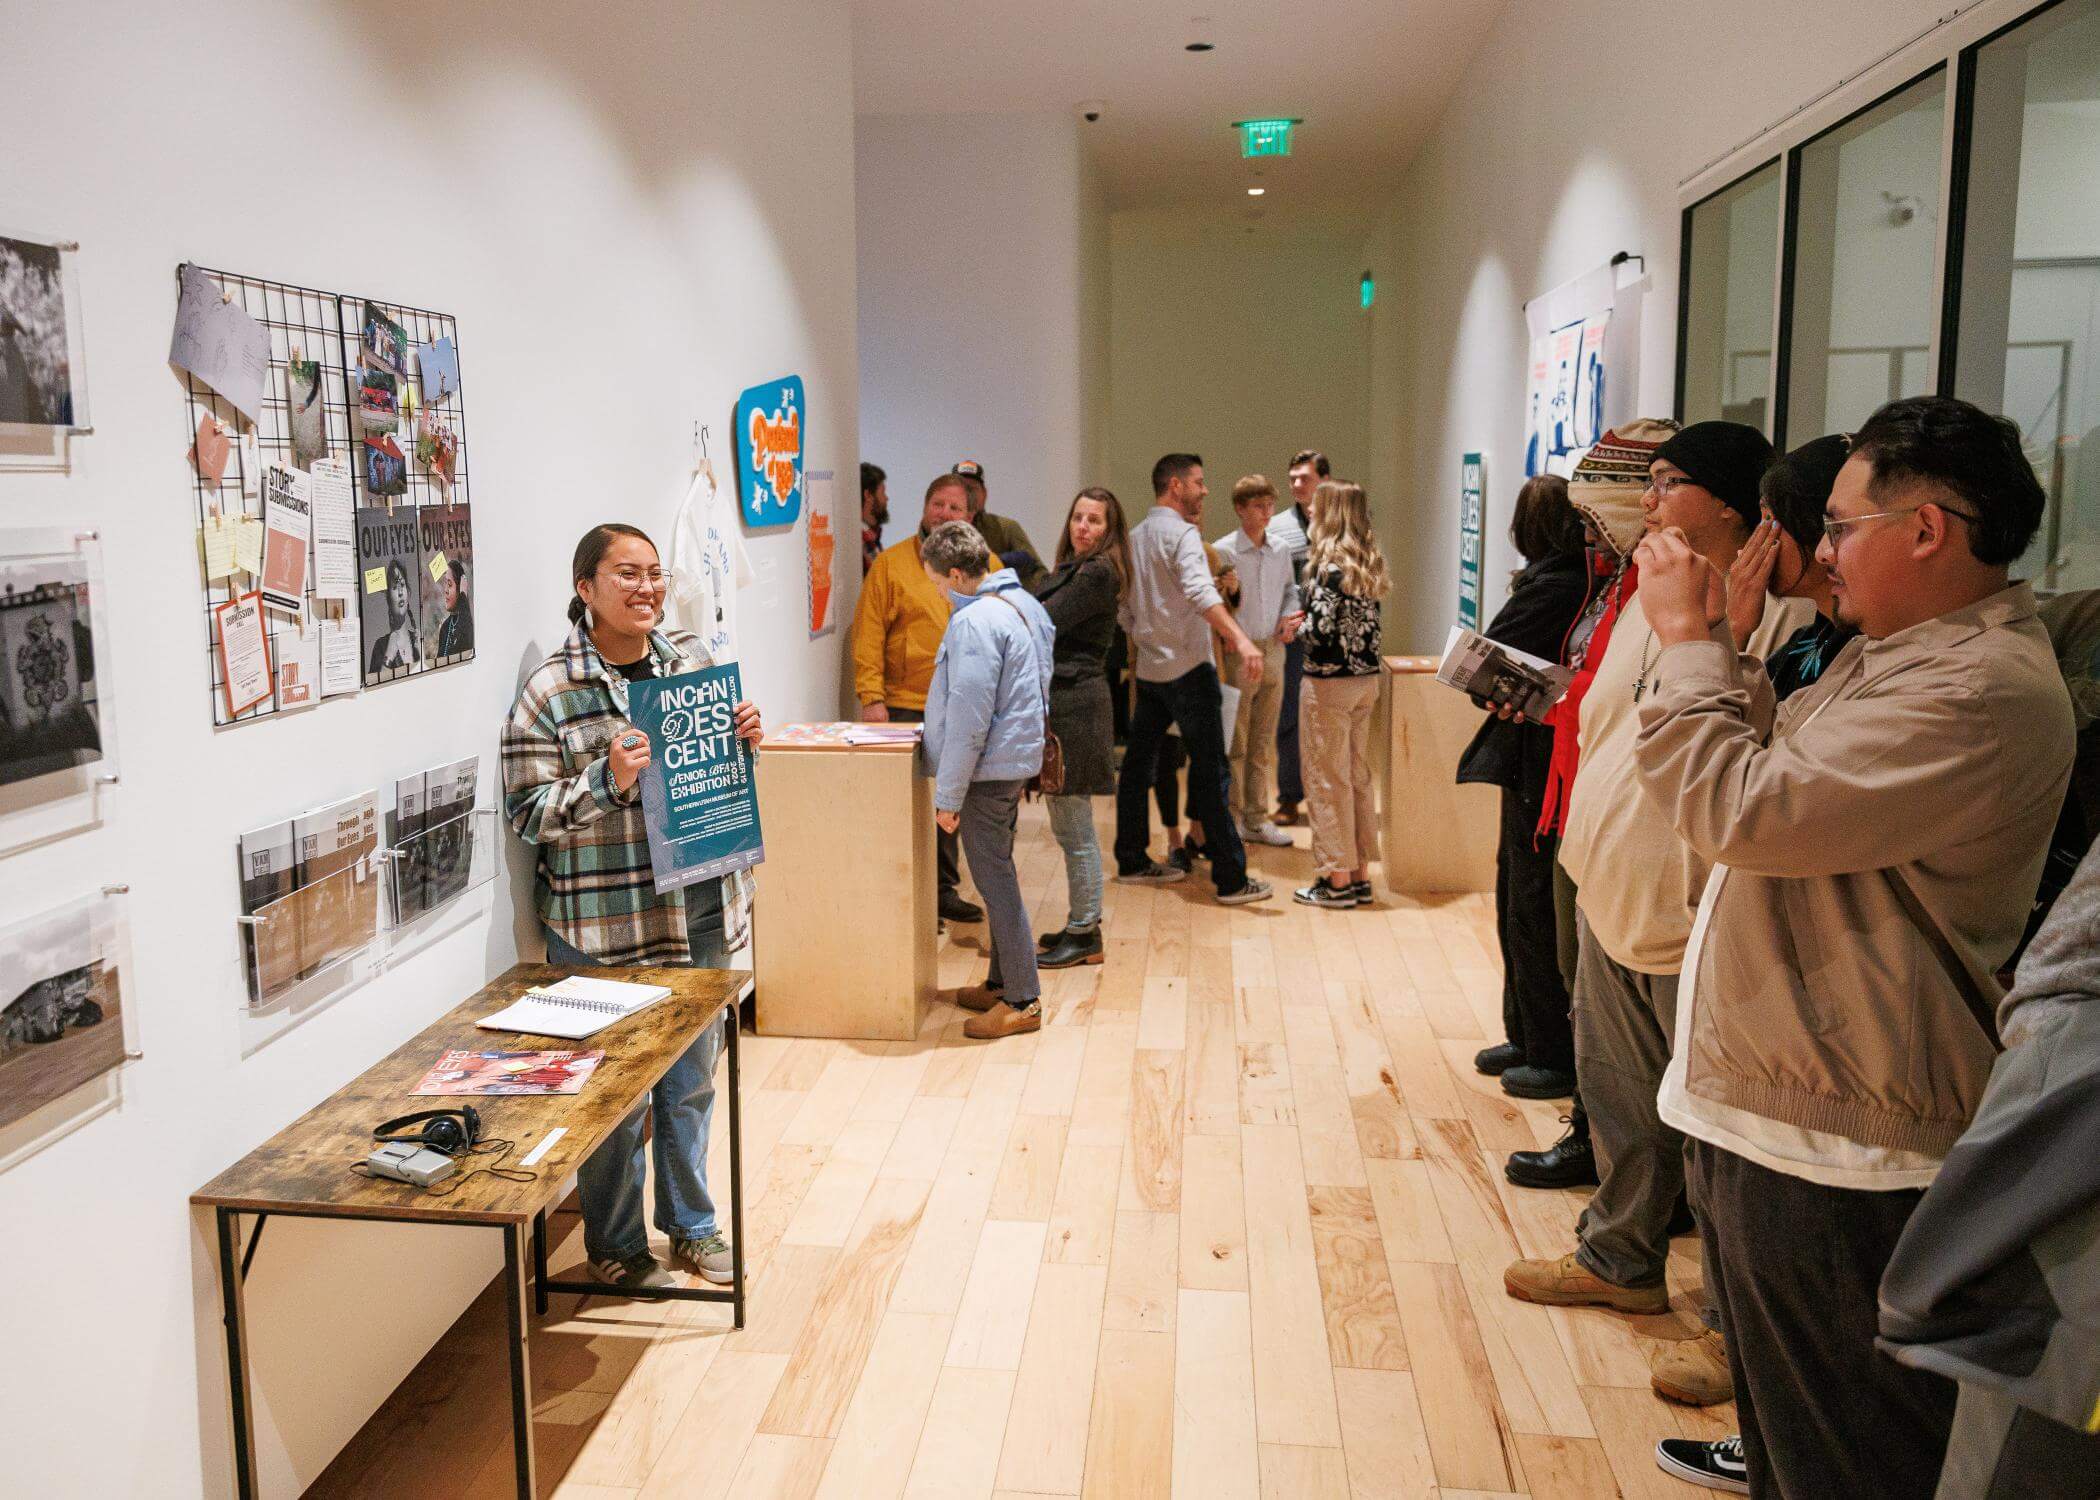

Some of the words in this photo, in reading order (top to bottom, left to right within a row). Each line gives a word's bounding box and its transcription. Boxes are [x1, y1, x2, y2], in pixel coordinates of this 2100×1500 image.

[1248, 126, 1288, 156] EXIT
[269, 466, 295, 495] STORY
[268, 488, 309, 516] SUBMISSIONS
[361, 524, 389, 559] OUR
[390, 522, 416, 556] EYES
[422, 520, 446, 552] OUR
[446, 518, 471, 550] EYES
[225, 606, 255, 627] SUBMISSION
[281, 662, 299, 687] STORY
[660, 677, 728, 713] INCAN
[661, 702, 732, 743] DES
[664, 731, 734, 769] CENT
[668, 768, 707, 787] SENIOR
[709, 761, 731, 777] BFA
[671, 774, 731, 800] EXHIBITION
[711, 792, 733, 805] MUSEUM
[337, 814, 360, 833] Through
